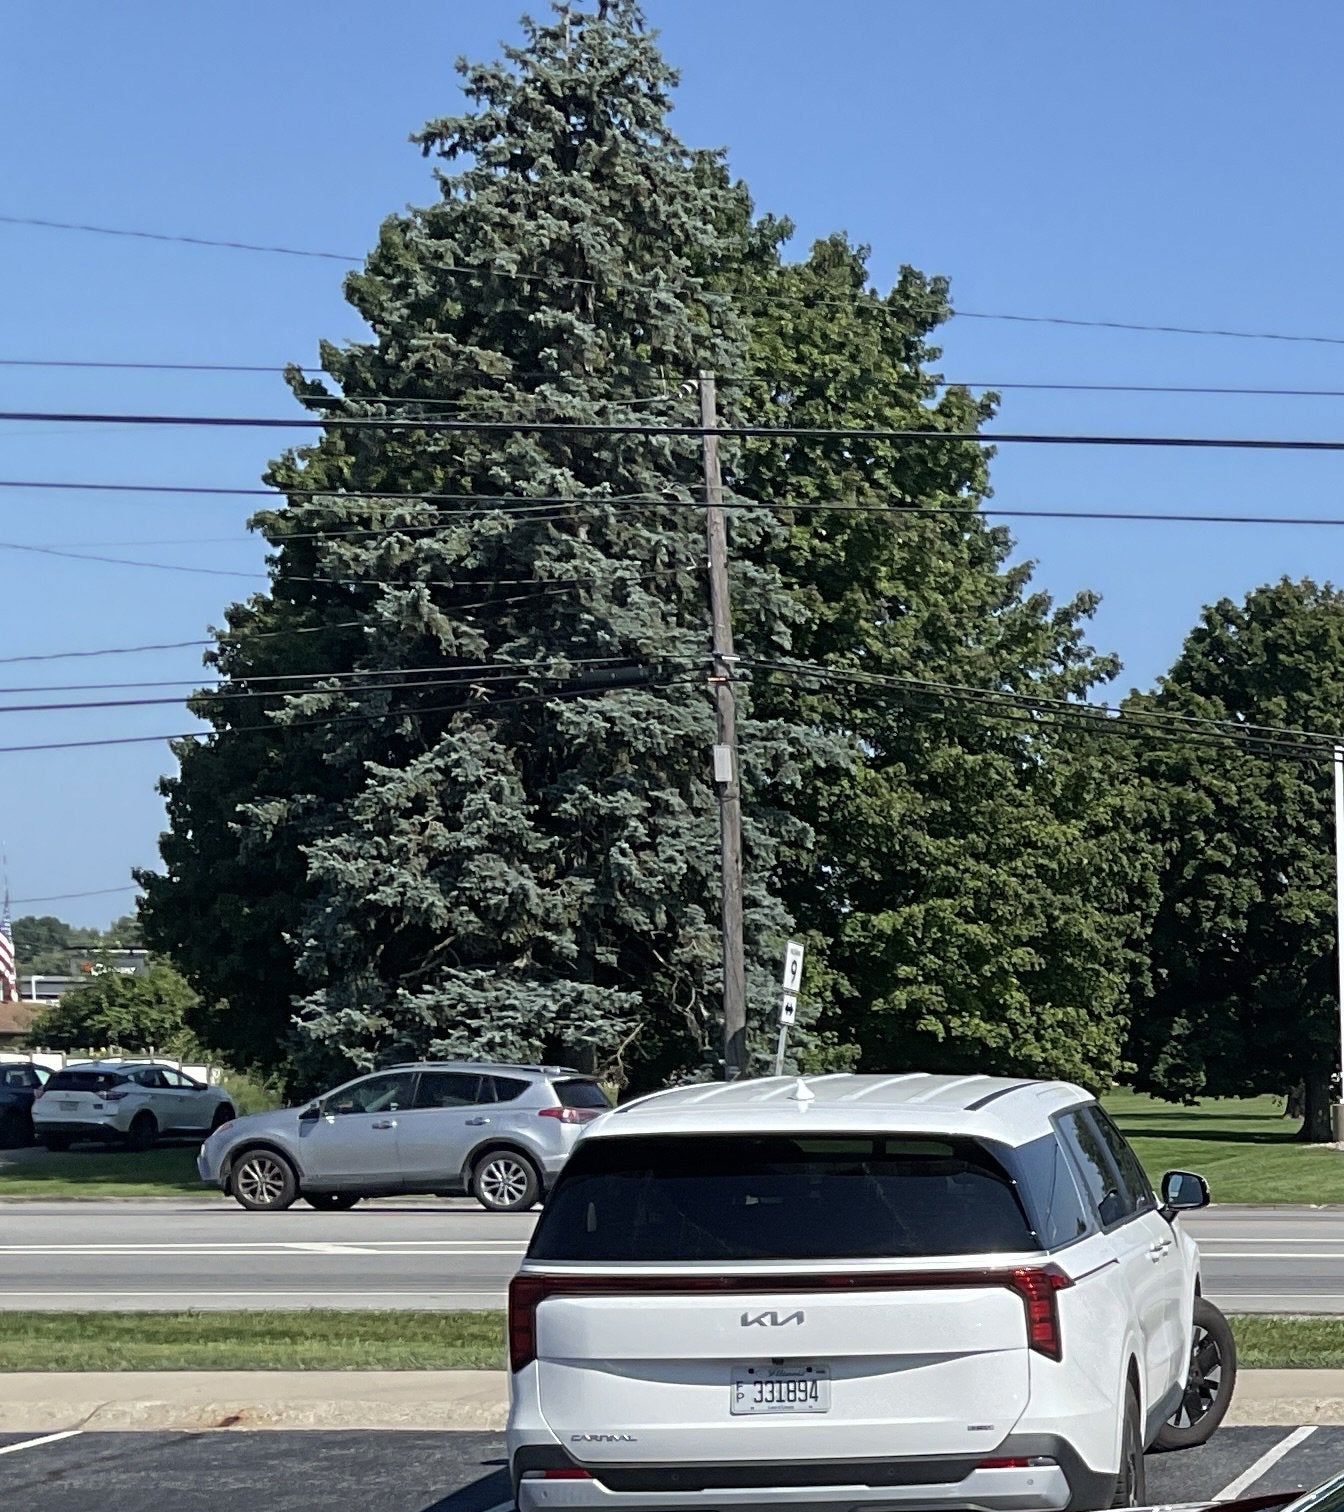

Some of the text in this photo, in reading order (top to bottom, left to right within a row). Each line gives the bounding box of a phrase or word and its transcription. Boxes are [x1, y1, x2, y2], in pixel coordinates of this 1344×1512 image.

[790, 960, 798, 985] 9
[740, 1310, 804, 1327] KIA
[753, 1379, 819, 1403] 331894
